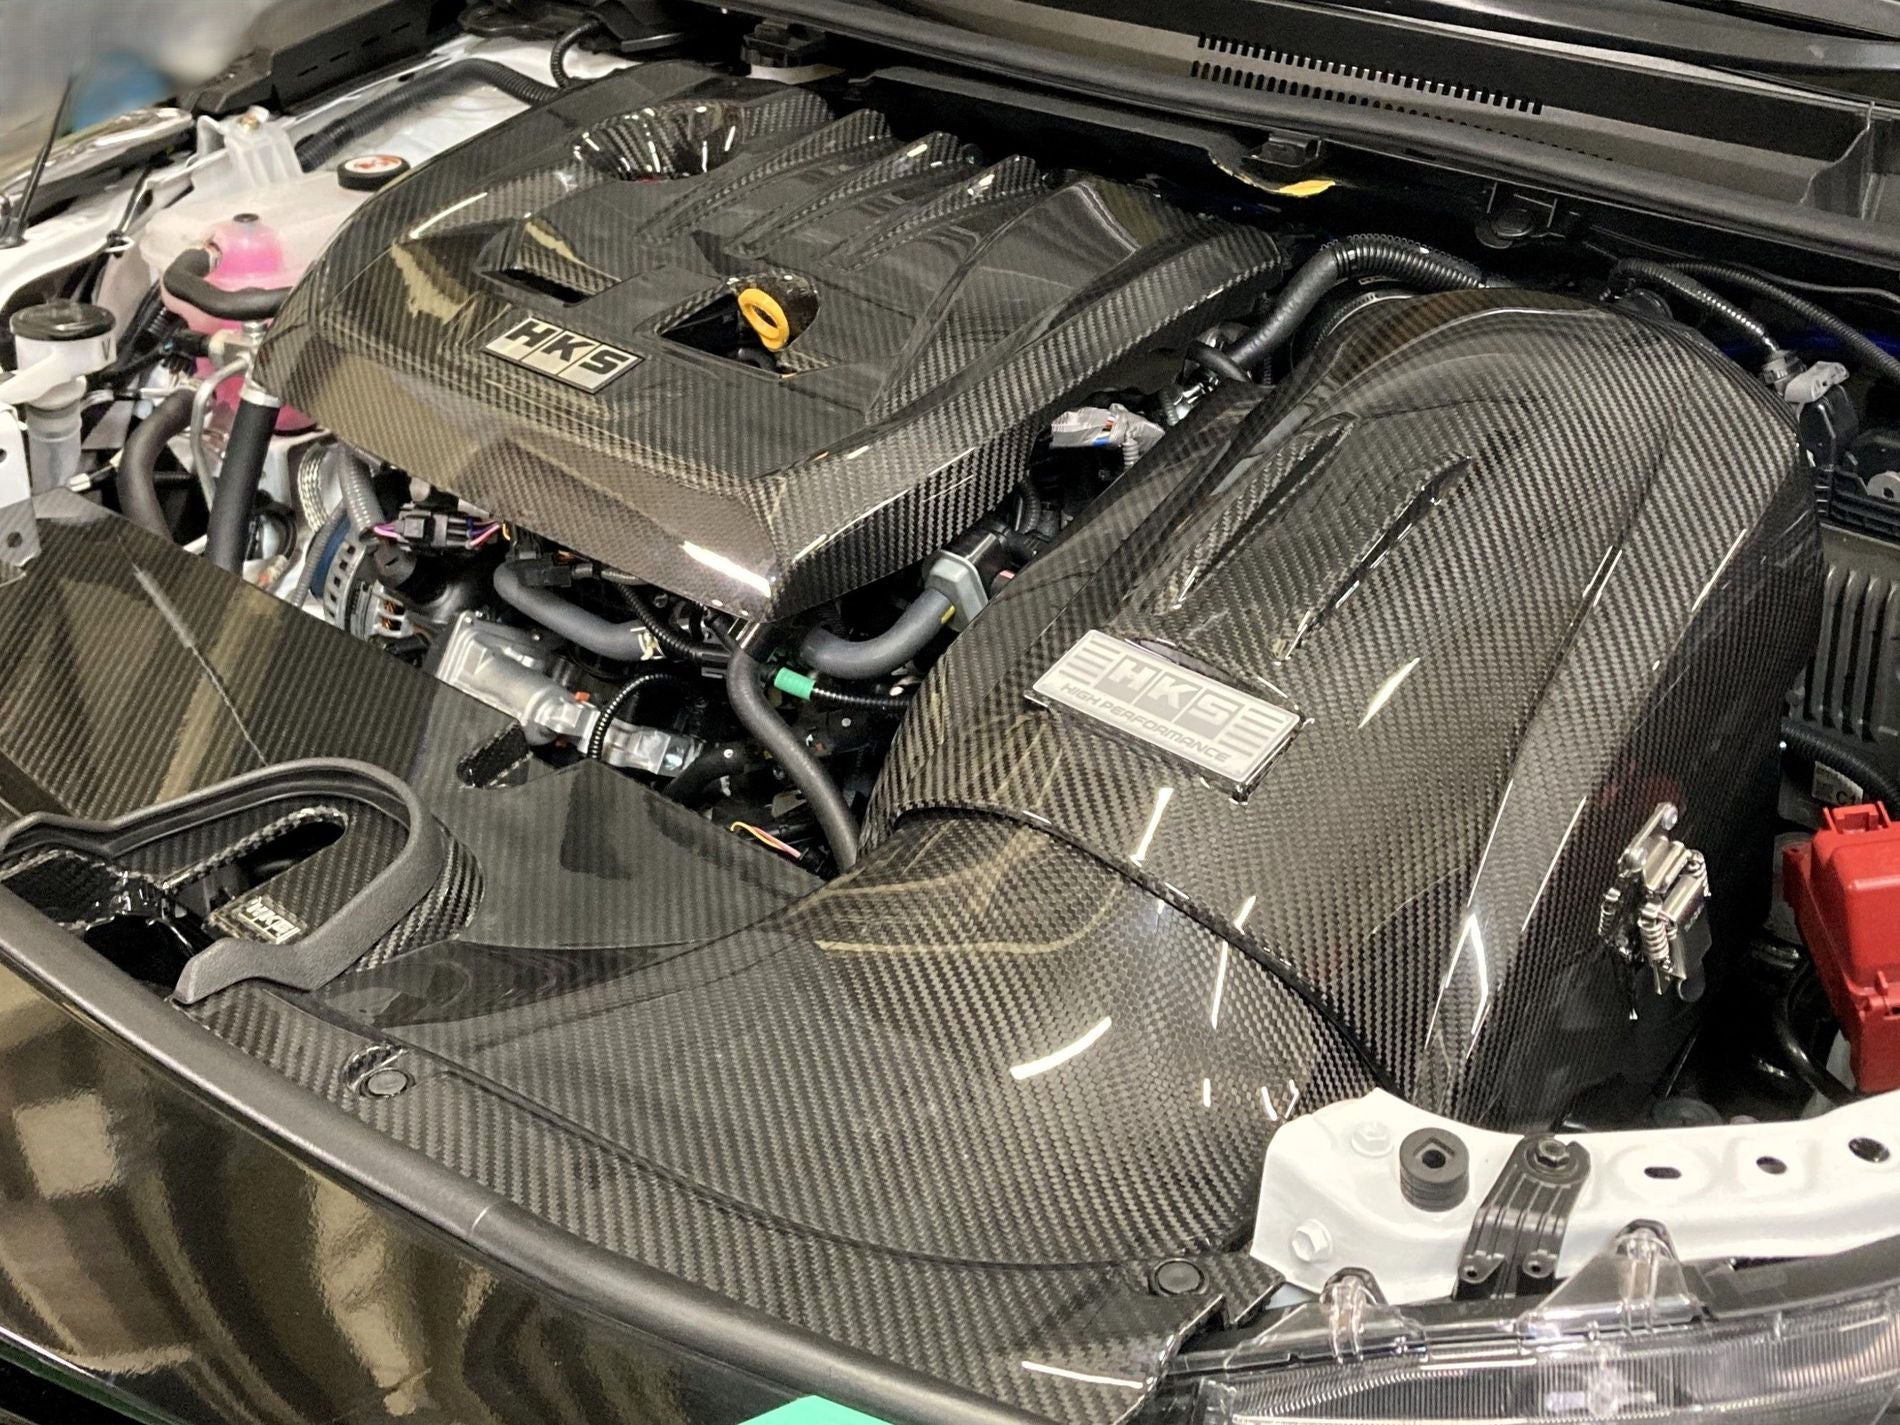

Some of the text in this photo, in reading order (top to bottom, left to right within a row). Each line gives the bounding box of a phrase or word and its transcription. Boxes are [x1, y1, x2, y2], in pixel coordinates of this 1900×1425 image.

[505, 321, 630, 375] HKS
[1060, 683, 1231, 763] HIGH PERFORMANCE
[1108, 659, 1236, 727] HKS
